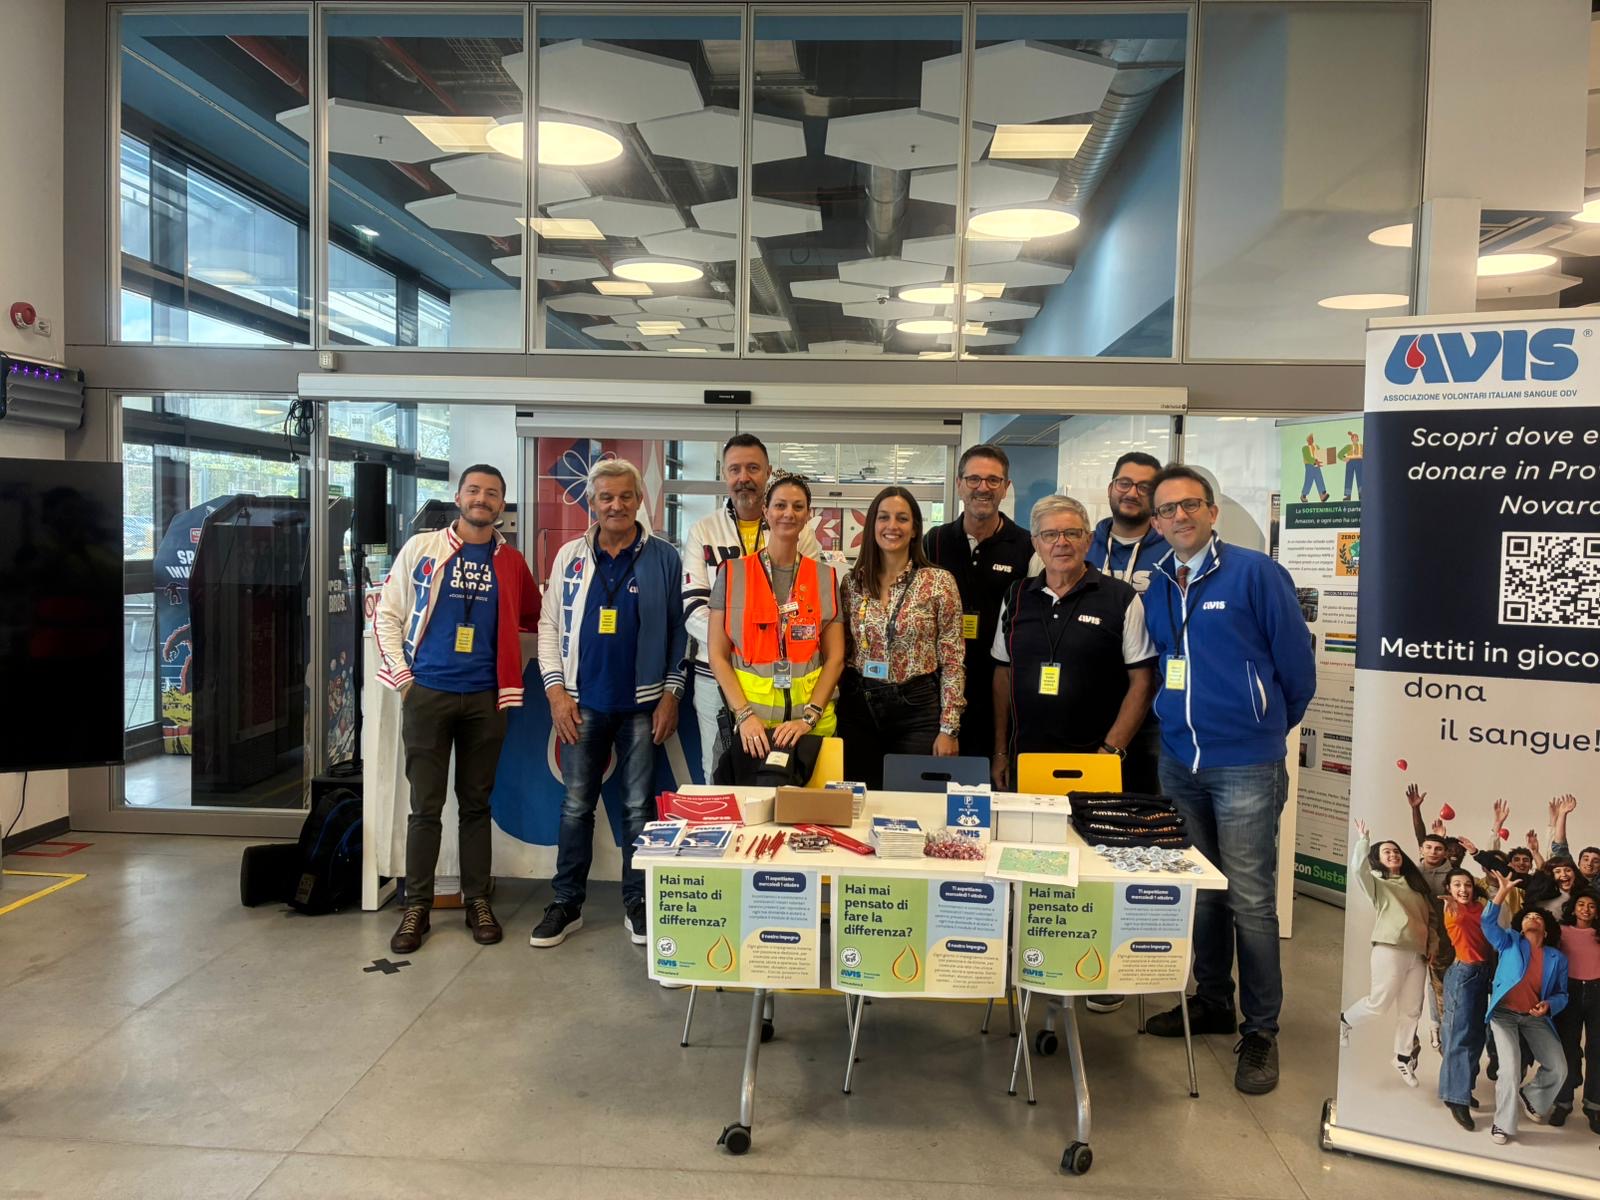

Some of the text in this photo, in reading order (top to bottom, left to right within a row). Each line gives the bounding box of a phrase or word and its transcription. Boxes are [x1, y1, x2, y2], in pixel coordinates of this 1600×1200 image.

[1384, 328, 1579, 385] AVIS
[1383, 389, 1578, 402] ASSOCIAZIONE VOLONTARI ITALIANI SANGUE ODV
[1411, 426, 1599, 451] Scopri dove e
[1408, 460, 1600, 481] donare in Pro
[992, 563, 1013, 573] AVIS
[1203, 601, 1226, 610] AVIS
[1078, 614, 1102, 625] AVIS
[1380, 637, 1475, 661] Mettiti
[1484, 641, 1508, 664] in
[1404, 677, 1487, 702] dona
[1440, 718, 1600, 755] il sangue!
[660, 874, 704, 886] Hai mai
[659, 889, 722, 901] pensato di
[845, 883, 890, 896] Hai mai
[1029, 887, 1075, 899] Hai mai
[659, 901, 697, 912] fare la
[845, 899, 908, 910] pensato di
[1028, 902, 1093, 913] pensato di
[659, 914, 727, 928] differenza?
[844, 910, 882, 923] fare la
[1027, 913, 1066, 925] fare la
[844, 924, 913, 938] differenza?
[1027, 926, 1097, 939] differenza?
